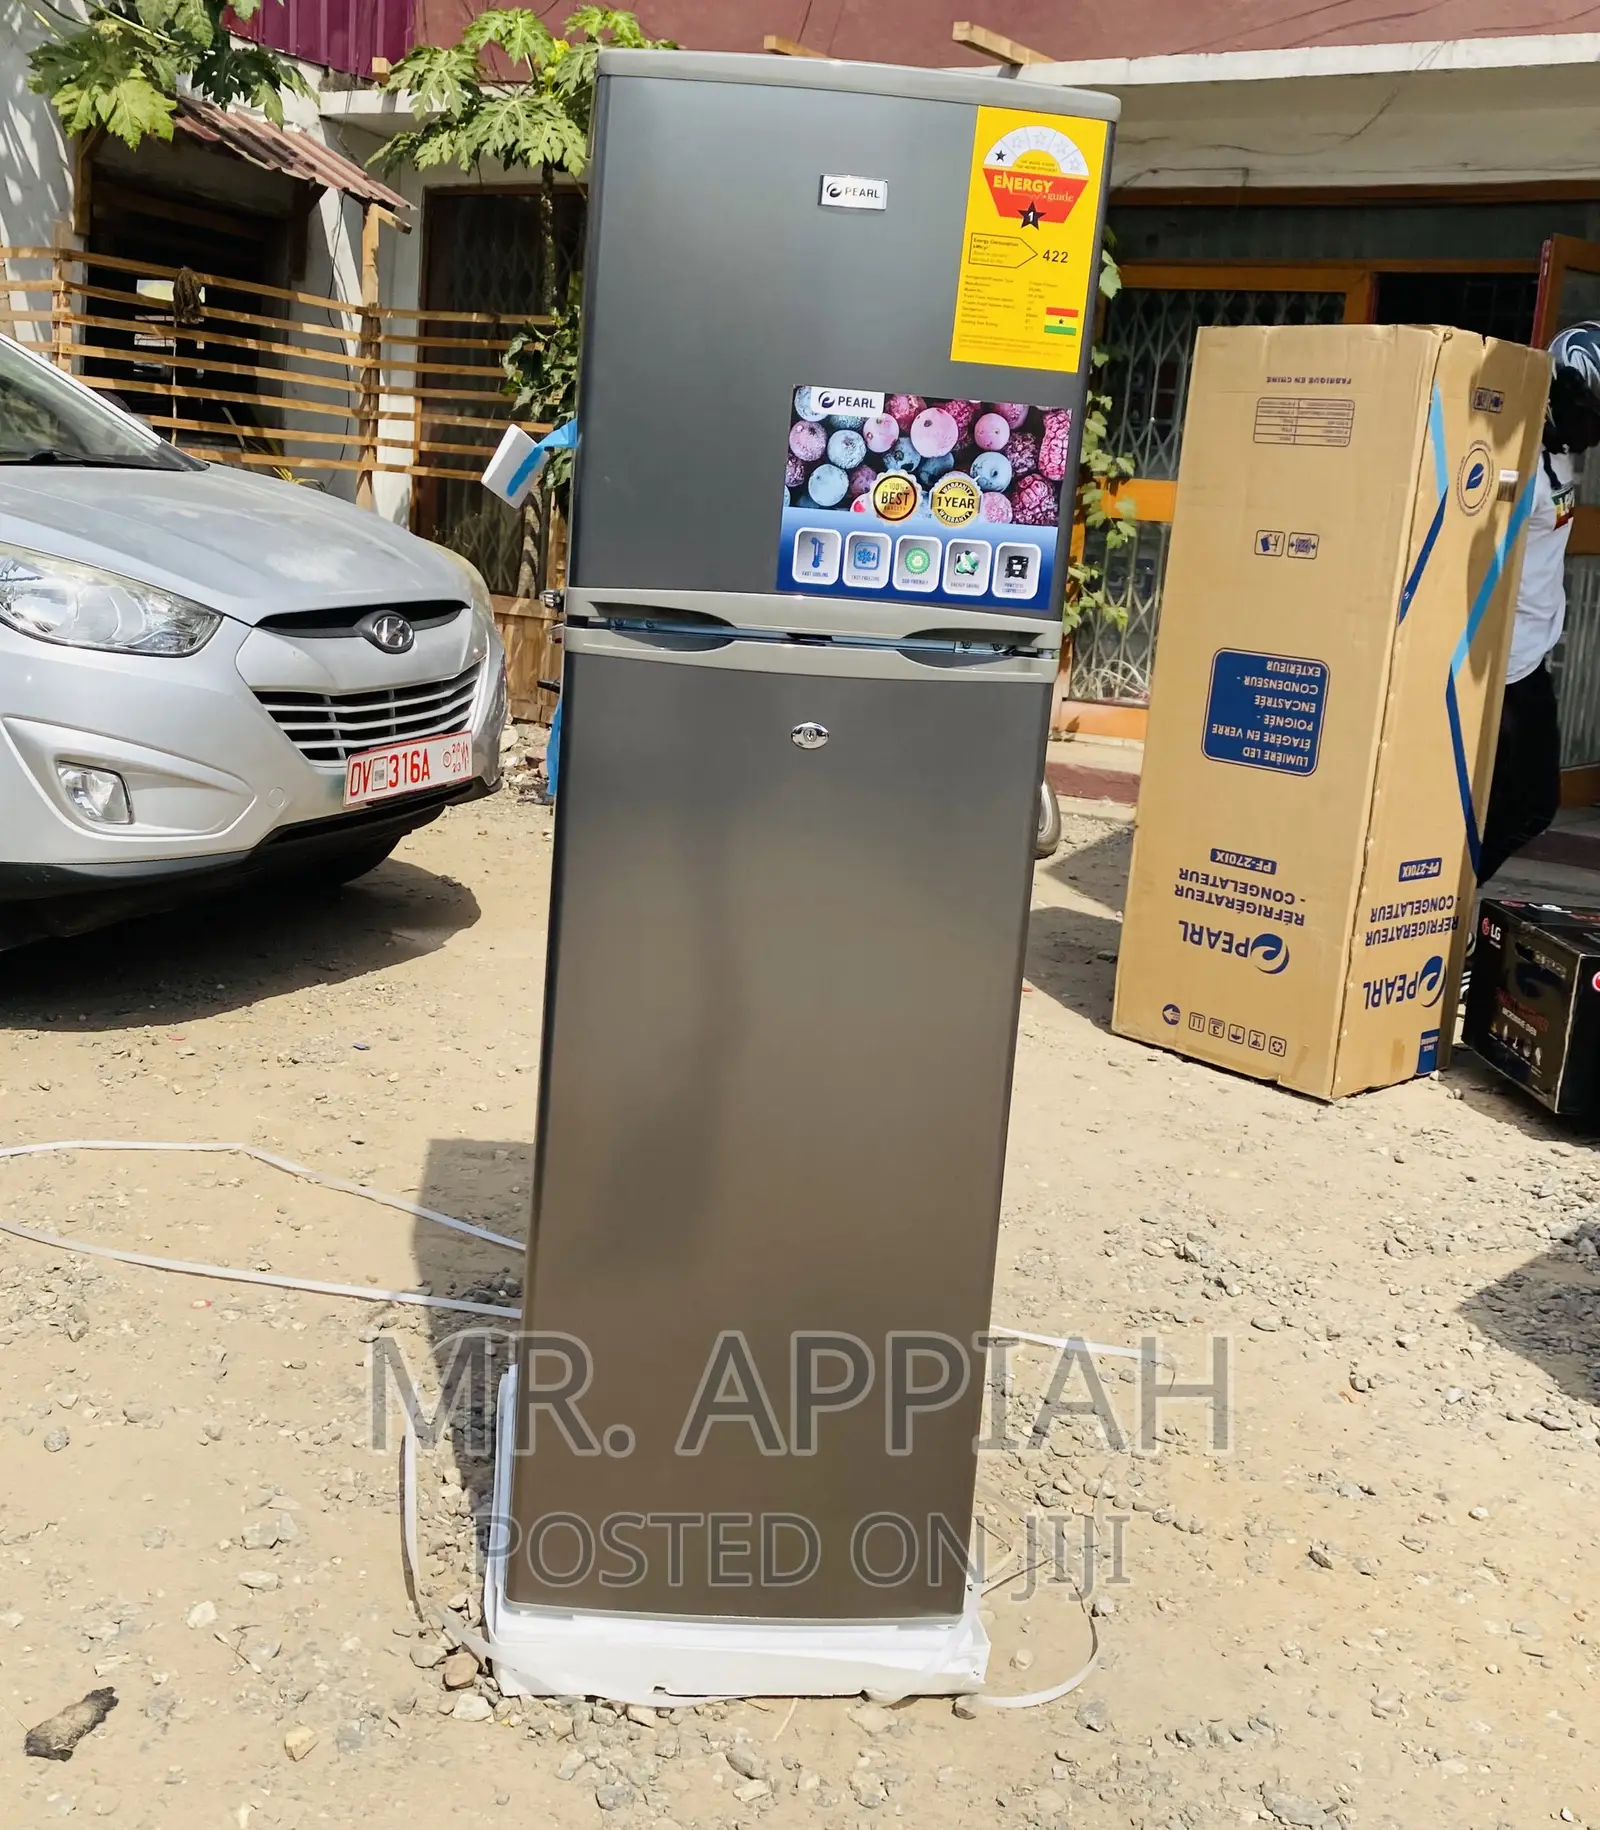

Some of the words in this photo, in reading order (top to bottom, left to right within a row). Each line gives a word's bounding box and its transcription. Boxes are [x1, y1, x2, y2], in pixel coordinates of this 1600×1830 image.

[993, 171, 1054, 195] ENERGY
[844, 186, 881, 199] PEARL
[1047, 192, 1074, 203] guide
[1028, 211, 1034, 222] 1
[1042, 249, 1069, 263] 422
[838, 395, 876, 410] PEARL
[941, 481, 974, 497] WARRANTY
[881, 491, 910, 506] BEST
[939, 509, 971, 523] WARRANTY
[1266, 660, 1321, 678] EXTÉRIEUR
[1244, 675, 1319, 695] CONDENSEUR
[1254, 694, 1316, 713] ENCASTRÉE
[1211, 723, 1243, 738] VERRE
[1263, 714, 1314, 732] POIGNÉE
[1246, 729, 1260, 741] EN
[1263, 732, 1311, 752] ÉTAGÈRE
[1242, 746, 1261, 759] LED
[1263, 749, 1309, 768] LUMIÈRE
[350, 759, 373, 797] DV
[388, 748, 431, 788] 316A
[1215, 850, 1273, 873] PF-270IX
[1402, 861, 1440, 878] PF-270IX
[1178, 867, 1296, 905] CONGELATEUR
[1174, 883, 1306, 927] RÉFRIGÉRATEUR
[1370, 894, 1454, 923] CONGELATEUR
[1178, 920, 1250, 958] PEARL
[1365, 915, 1460, 947] RÉFRIGÉRATEUR
[1490, 923, 1501, 941] LG
[1363, 971, 1419, 1010] PEARL
